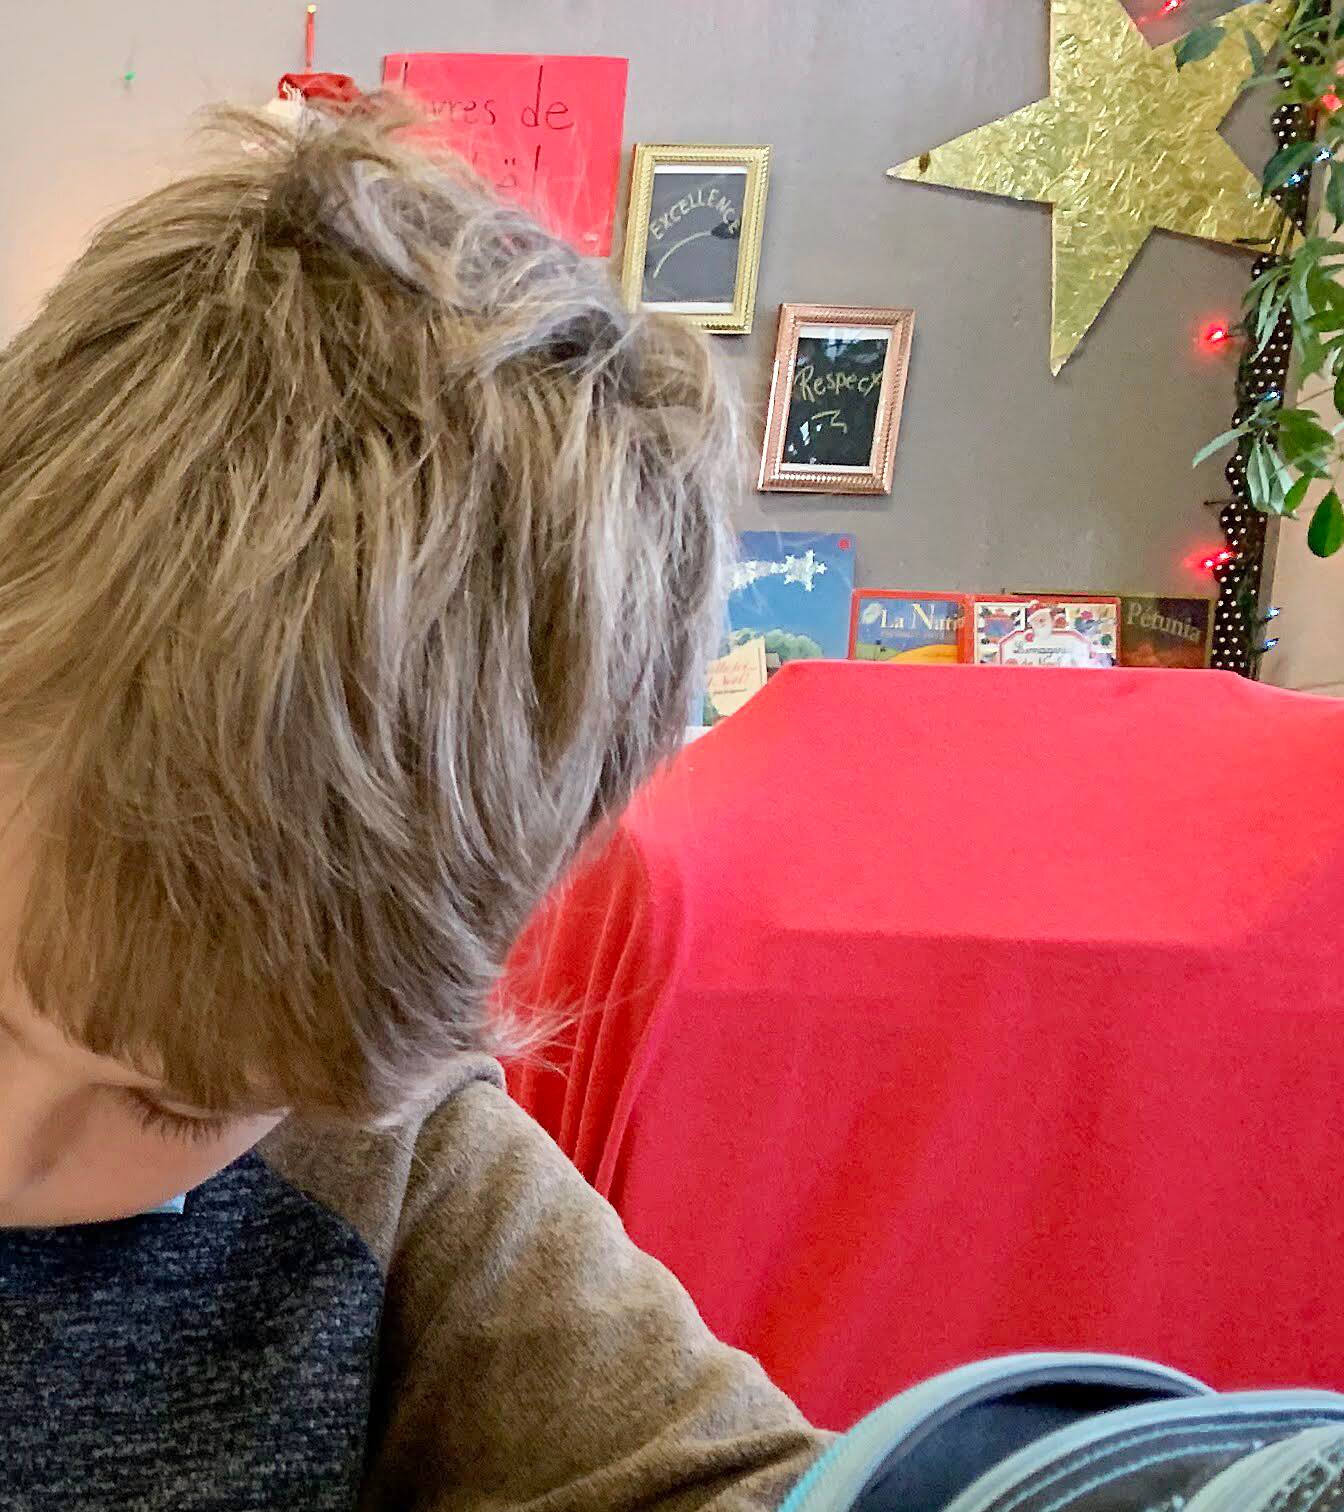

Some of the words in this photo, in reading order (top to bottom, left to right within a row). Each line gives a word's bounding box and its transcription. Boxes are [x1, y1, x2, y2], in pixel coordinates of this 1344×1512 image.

[520, 64, 575, 131] de
[649, 187, 742, 241] EXCELLENCE
[879, 607, 906, 629] La
[1125, 603, 1203, 644] Pétunia
